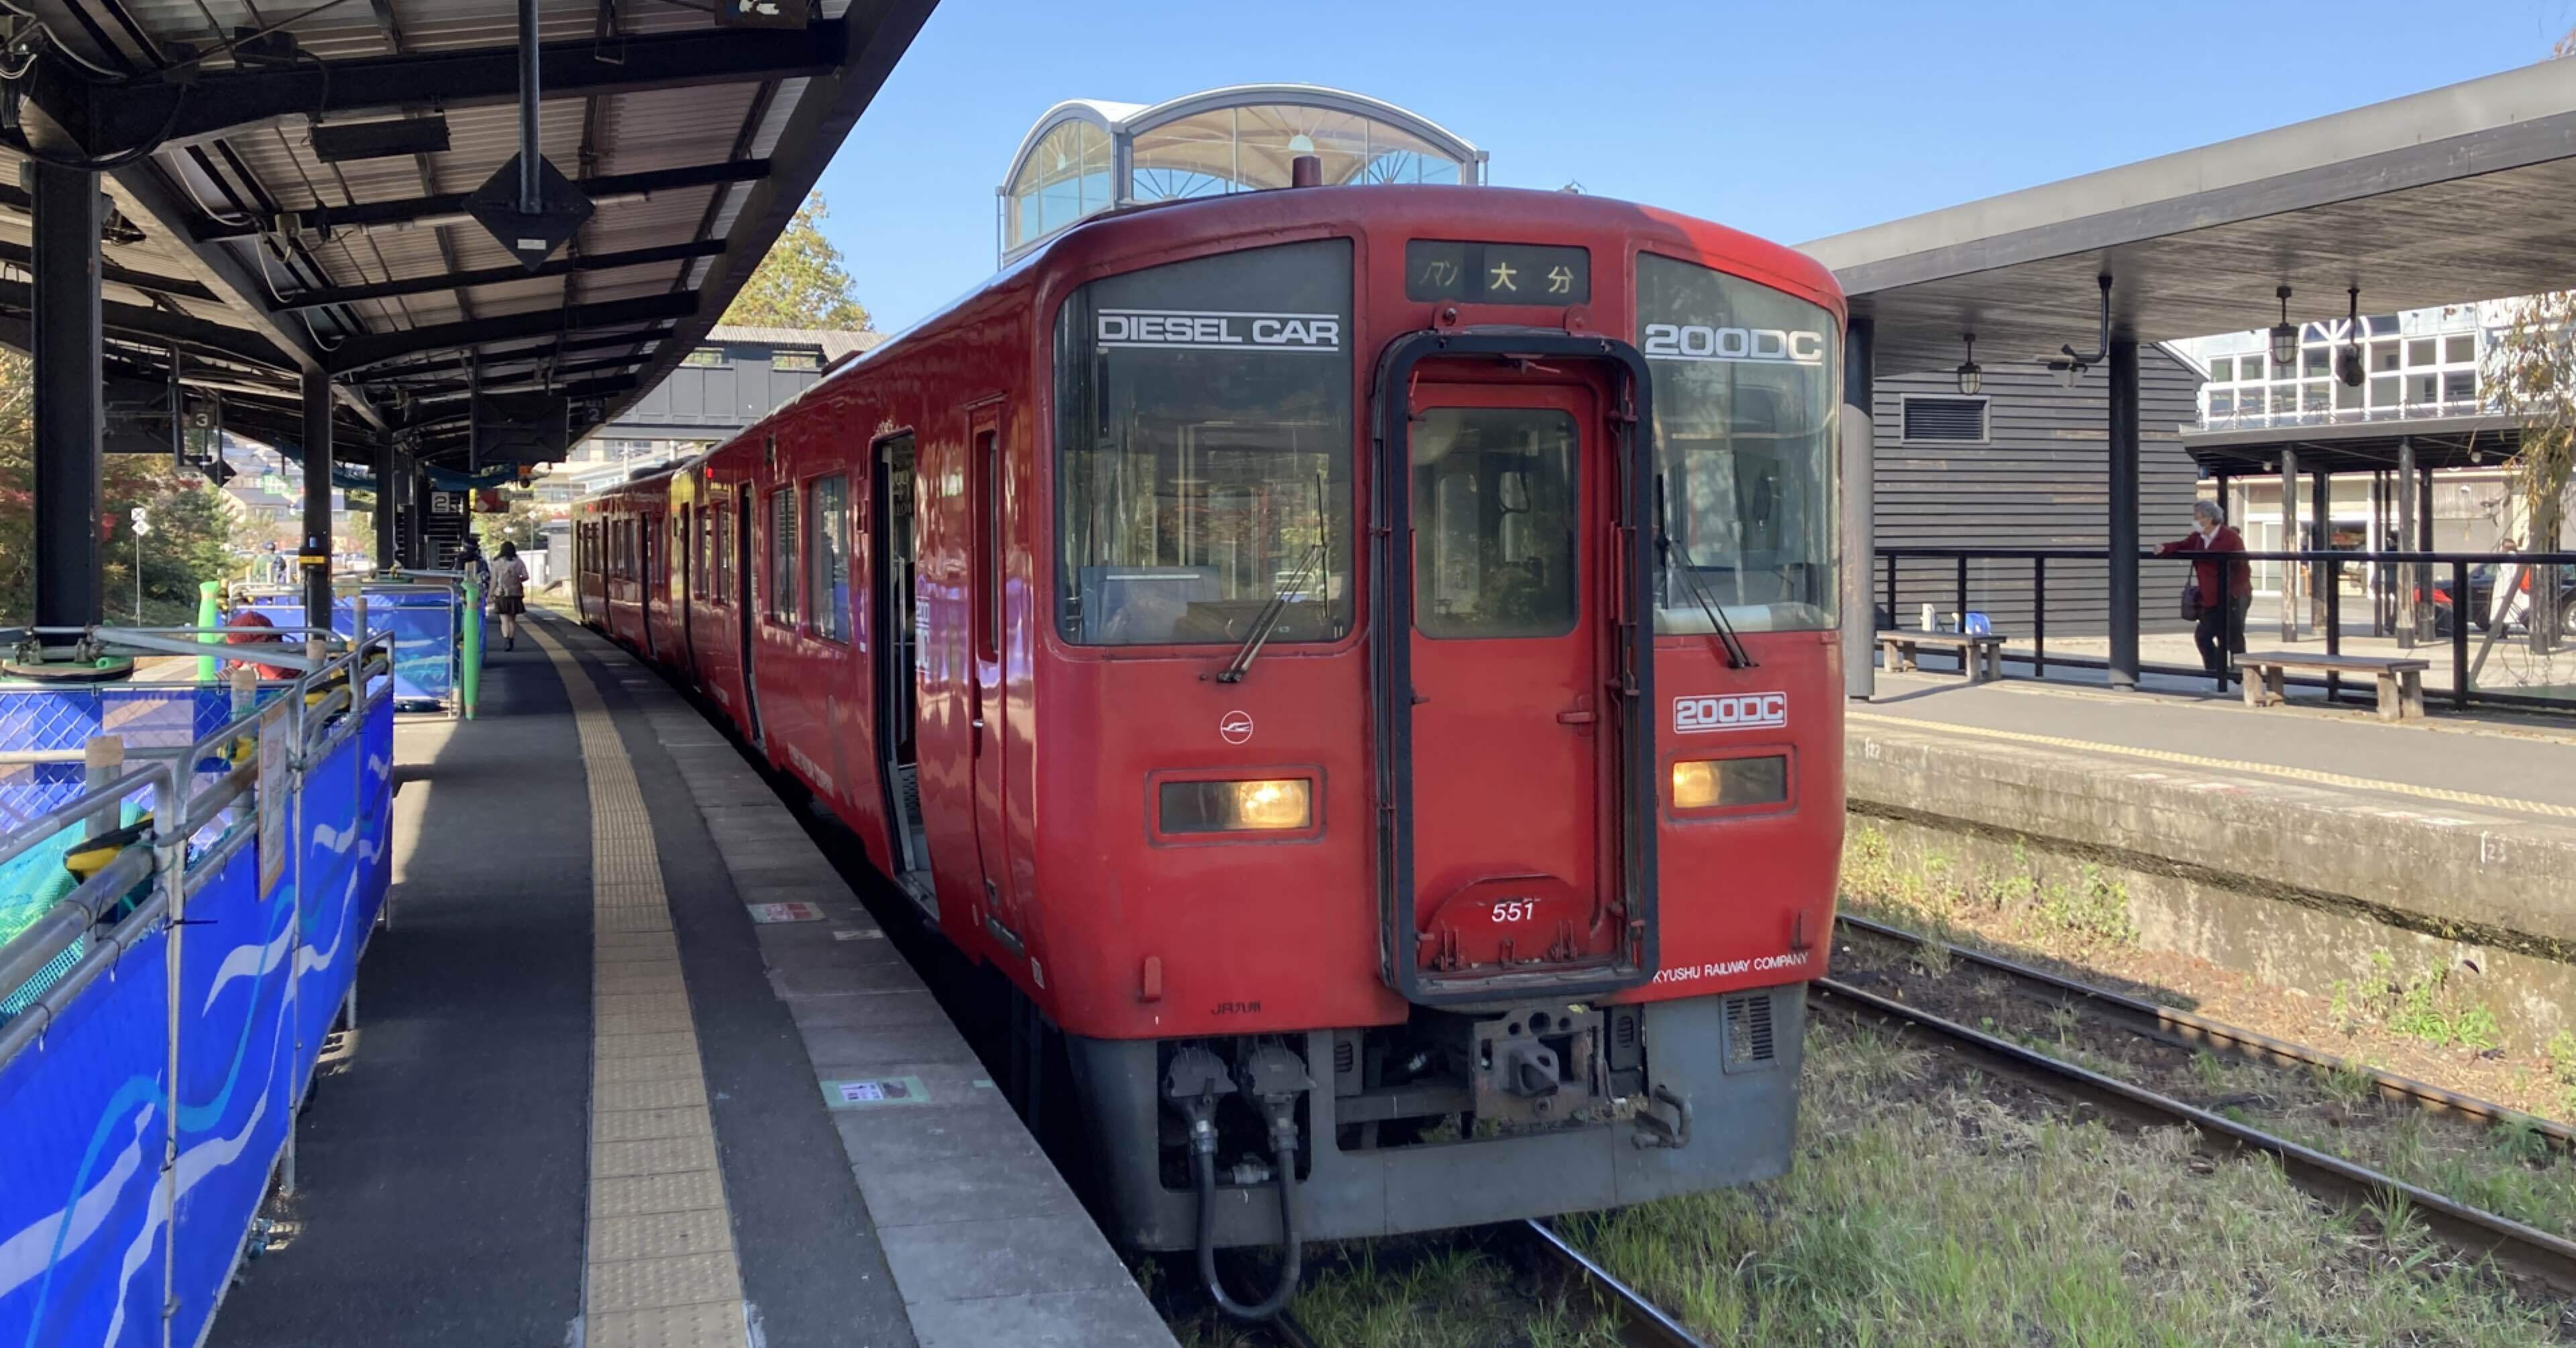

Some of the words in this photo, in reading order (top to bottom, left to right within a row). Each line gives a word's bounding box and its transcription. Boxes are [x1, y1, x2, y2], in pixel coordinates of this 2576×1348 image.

[1098, 316, 1243, 343] DIESEL
[1252, 319, 1339, 345] CAR
[1645, 324, 1823, 360] 200DC
[195, 413, 209, 427] 3
[434, 495, 447, 509] 2
[1677, 696, 1784, 725] 200DC
[1491, 902, 1533, 923] 551
[1652, 966, 1701, 984] KYUSHU
[1705, 960, 1750, 978] RAILWAY
[1754, 952, 1809, 971] COMPANY
